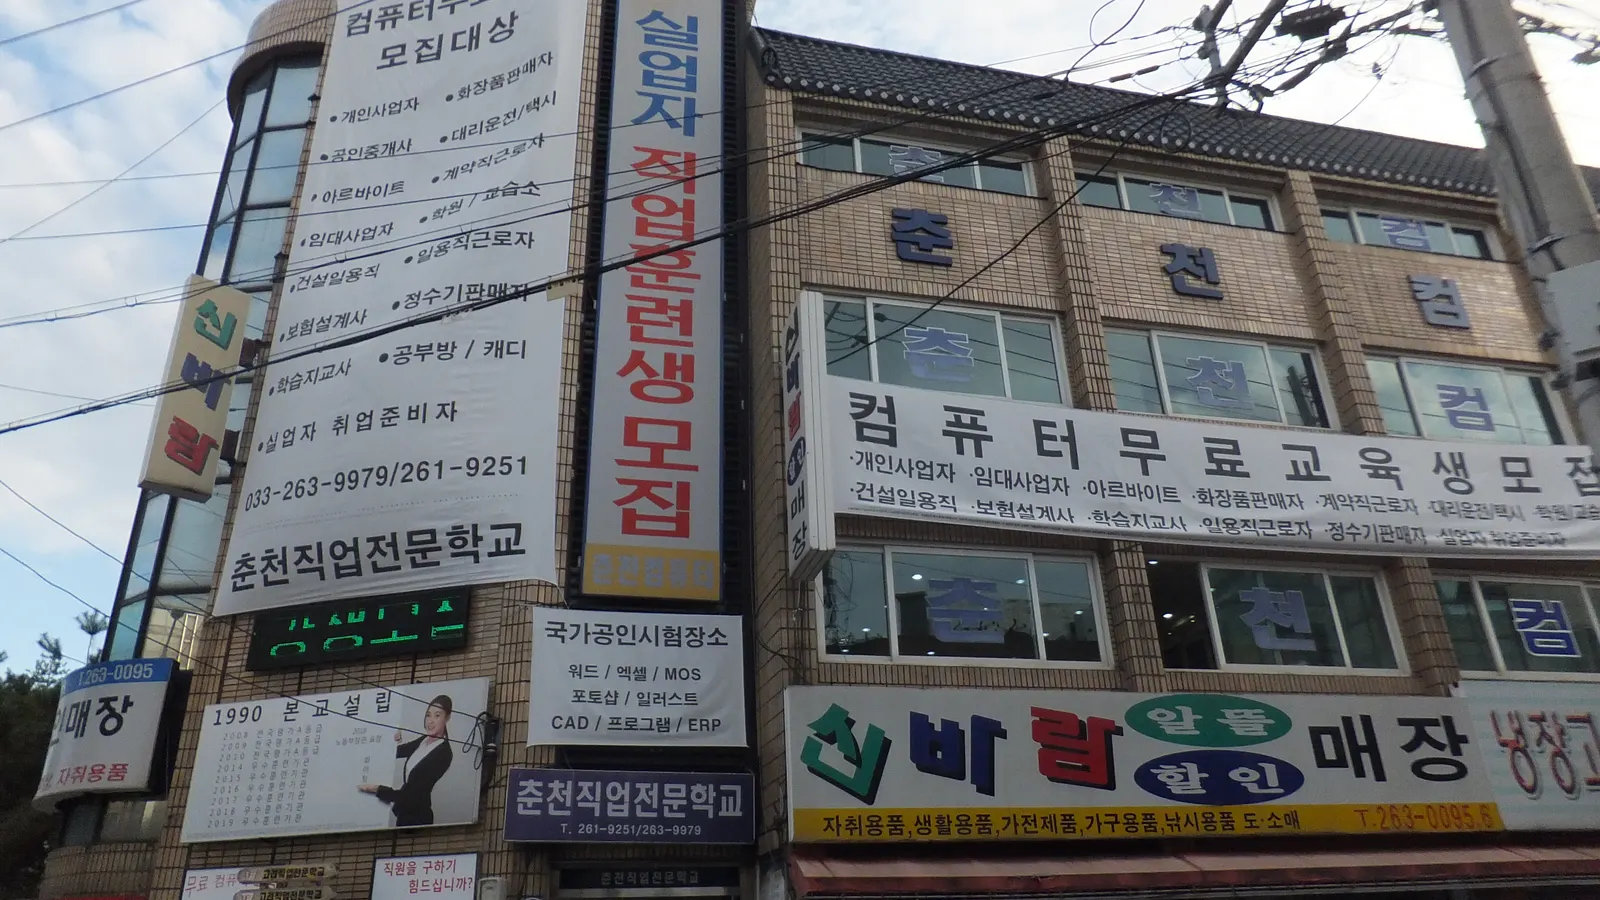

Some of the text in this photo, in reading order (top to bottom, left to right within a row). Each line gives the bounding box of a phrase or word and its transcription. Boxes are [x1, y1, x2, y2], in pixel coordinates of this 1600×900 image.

[376, 10, 519, 70] 모집대상
[341, 51, 554, 124] 개인사업자 화장품판매자
[630, 9, 703, 138] 실업자
[331, 90, 557, 164] 공인중개사 대리운전/택시
[322, 132, 545, 204] 아르바이트 계약직근로자
[296, 230, 535, 292] 건설일용직 일용직근로자
[308, 222, 394, 248] 임대사업자
[286, 282, 529, 342] 보험설계사 정수기판매자
[276, 358, 352, 396] 학습지교사
[392, 341, 458, 366] 공부방
[483, 339, 527, 360] 캐디
[264, 401, 458, 454] 실업자 취업준비자
[245, 455, 527, 512] 033-263-9979/261-9251
[855, 450, 956, 484] 개인사업자
[974, 466, 1070, 497] 임대사업자
[1088, 479, 1181, 504] 아르바이트
[1196, 487, 1304, 511] 화장품판매자
[1319, 493, 1418, 516] 계약직근로자
[855, 481, 957, 513] 건설일용직
[976, 499, 1075, 524] 보험설계사
[1091, 509, 1187, 532] 학습지교사
[1202, 516, 1312, 540] 일용직근로자
[1328, 521, 1427, 545] 정수기판매자
[230, 522, 526, 593] 춘천직업전문학교
[544, 620, 729, 648] 국가공인시험장소
[568, 664, 599, 680] 워드
[616, 665, 647, 682] 엑셀
[664, 667, 701, 681] MOS
[571, 689, 619, 706] 포토샵
[636, 692, 699, 707] 일러스트
[212, 704, 262, 726] 1990
[551, 715, 589, 730] CAD
[607, 717, 671, 733] 프로그램
[688, 718, 721, 732] ERP
[57, 763, 129, 785] 자취용품
[800, 702, 1469, 806] 신바람 알뜰 매장
[1149, 762, 1286, 795] 할인
[516, 779, 743, 818] 춘천직업전문학교
[185, 875, 208, 898] 무료
[384, 859, 456, 876] 직원을 구하기
[409, 877, 473, 894] 힘드십니까?
